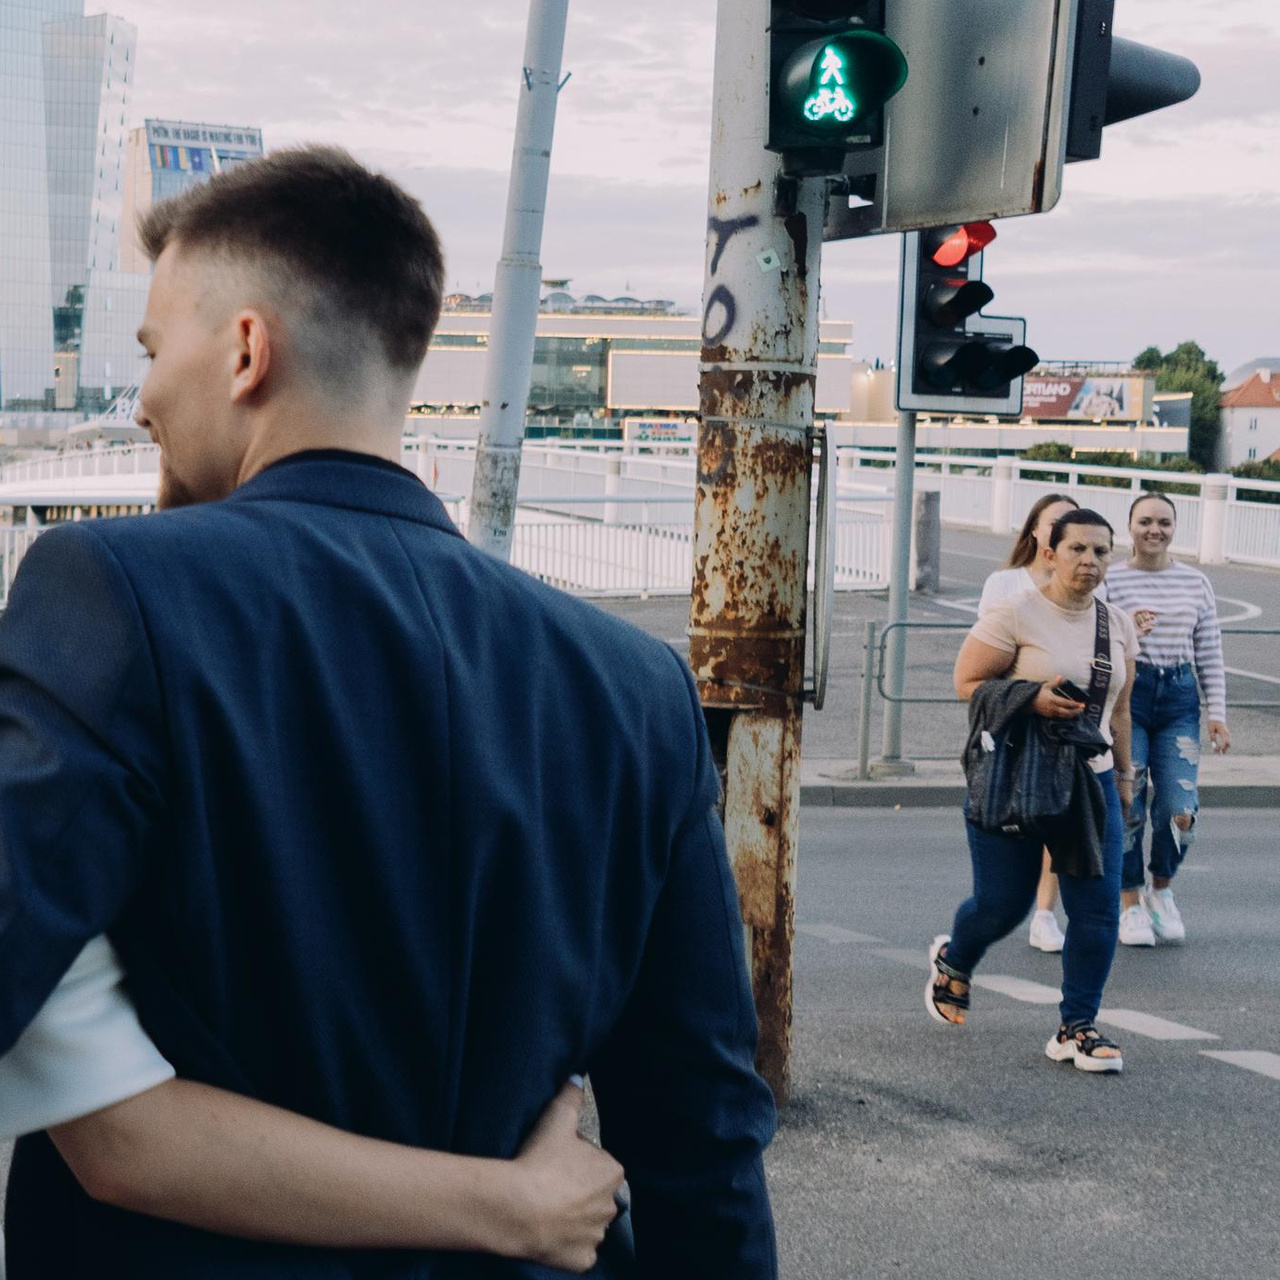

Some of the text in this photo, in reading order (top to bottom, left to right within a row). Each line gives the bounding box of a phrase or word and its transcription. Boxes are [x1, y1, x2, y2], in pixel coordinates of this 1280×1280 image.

[209, 131, 233, 144] WAITING
[1097, 604, 1109, 640] GUESS
[1093, 652, 1110, 689] GUSS
